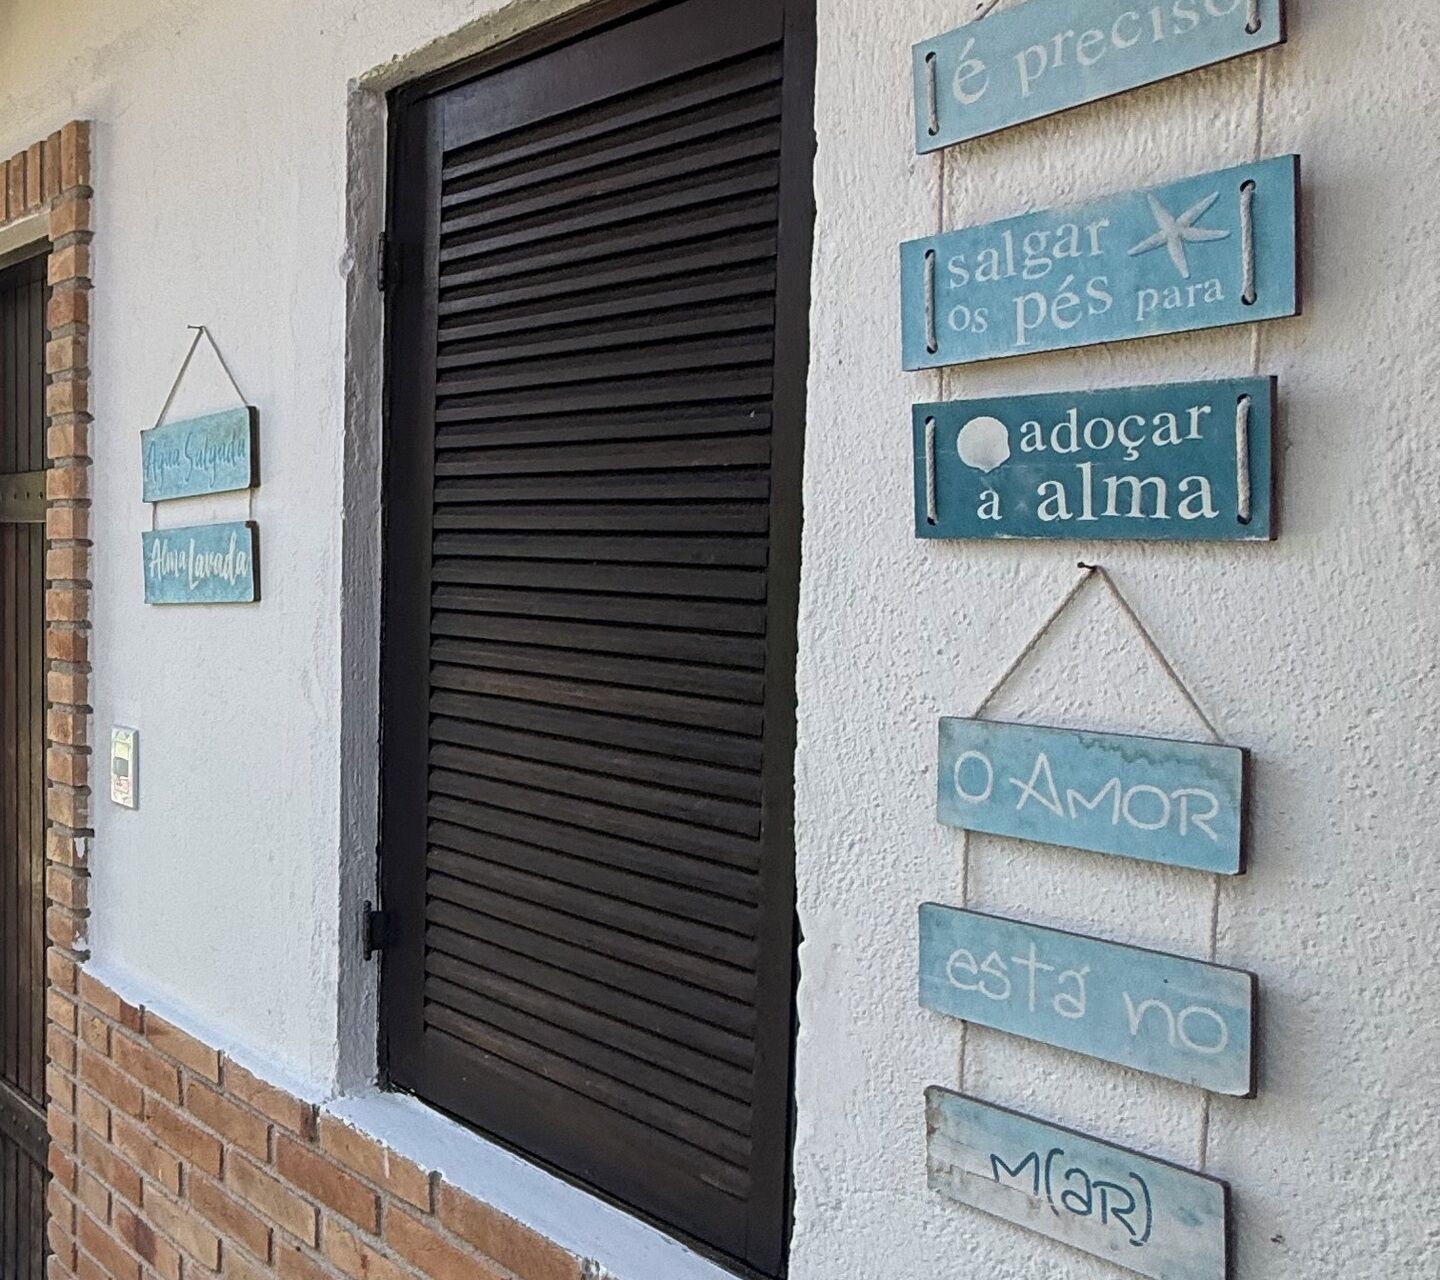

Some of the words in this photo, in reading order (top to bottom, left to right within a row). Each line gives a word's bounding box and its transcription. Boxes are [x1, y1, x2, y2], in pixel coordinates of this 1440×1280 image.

[951, 38, 990, 104] é
[947, 219, 1110, 288] salgar
[948, 303, 989, 334] os
[1014, 273, 1114, 345] pés
[1137, 277, 1225, 321] para
[1020, 401, 1210, 461] adoçar
[977, 486, 1002, 520] a
[1036, 462, 1219, 522] alma
[953, 750, 994, 803] O
[1009, 752, 1221, 842] AMOR
[1124, 991, 1229, 1055] no
